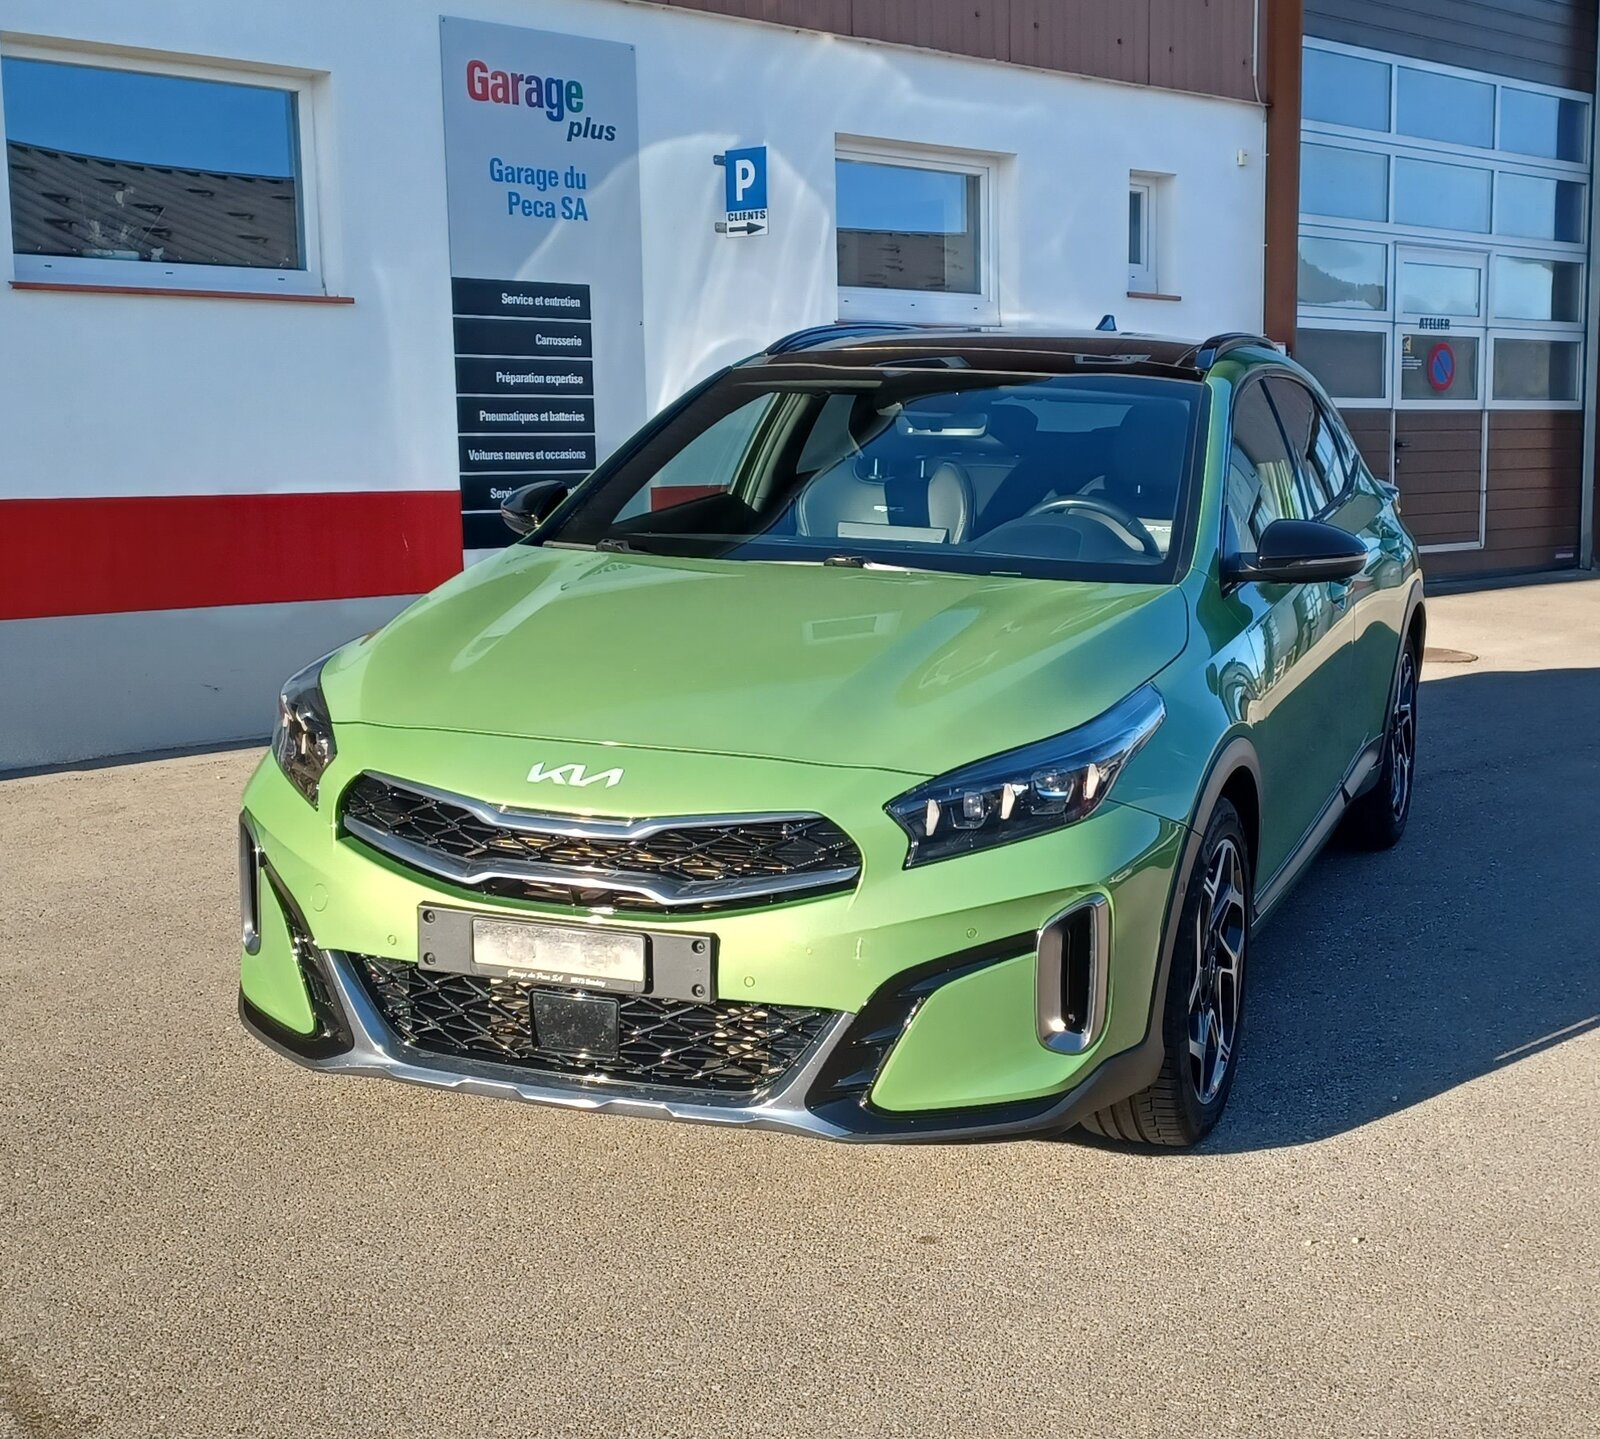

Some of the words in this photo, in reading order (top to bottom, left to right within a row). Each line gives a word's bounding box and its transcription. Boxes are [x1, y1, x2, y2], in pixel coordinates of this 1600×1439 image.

[466, 59, 584, 122] Garage
[567, 116, 617, 142] plus
[489, 157, 559, 192] Garage
[564, 165, 586, 190] du
[735, 159, 756, 201] P
[507, 191, 556, 219] Peca
[561, 197, 588, 221] SA
[728, 210, 766, 222] CLIENTS
[501, 292, 534, 305] Service
[534, 295, 544, 306] et
[544, 296, 581, 308] entretien
[1418, 317, 1451, 330] ATELIER
[535, 333, 582, 346] Carrosserie
[495, 371, 545, 386] Préparation
[545, 373, 584, 386] expertise
[479, 410, 539, 425] Pneumatiques
[540, 411, 549, 421] et
[549, 410, 585, 422] batteries
[467, 449, 504, 461] Voitures
[504, 451, 535, 460] neuves
[535, 450, 544, 460] et
[544, 448, 586, 460] occasions
